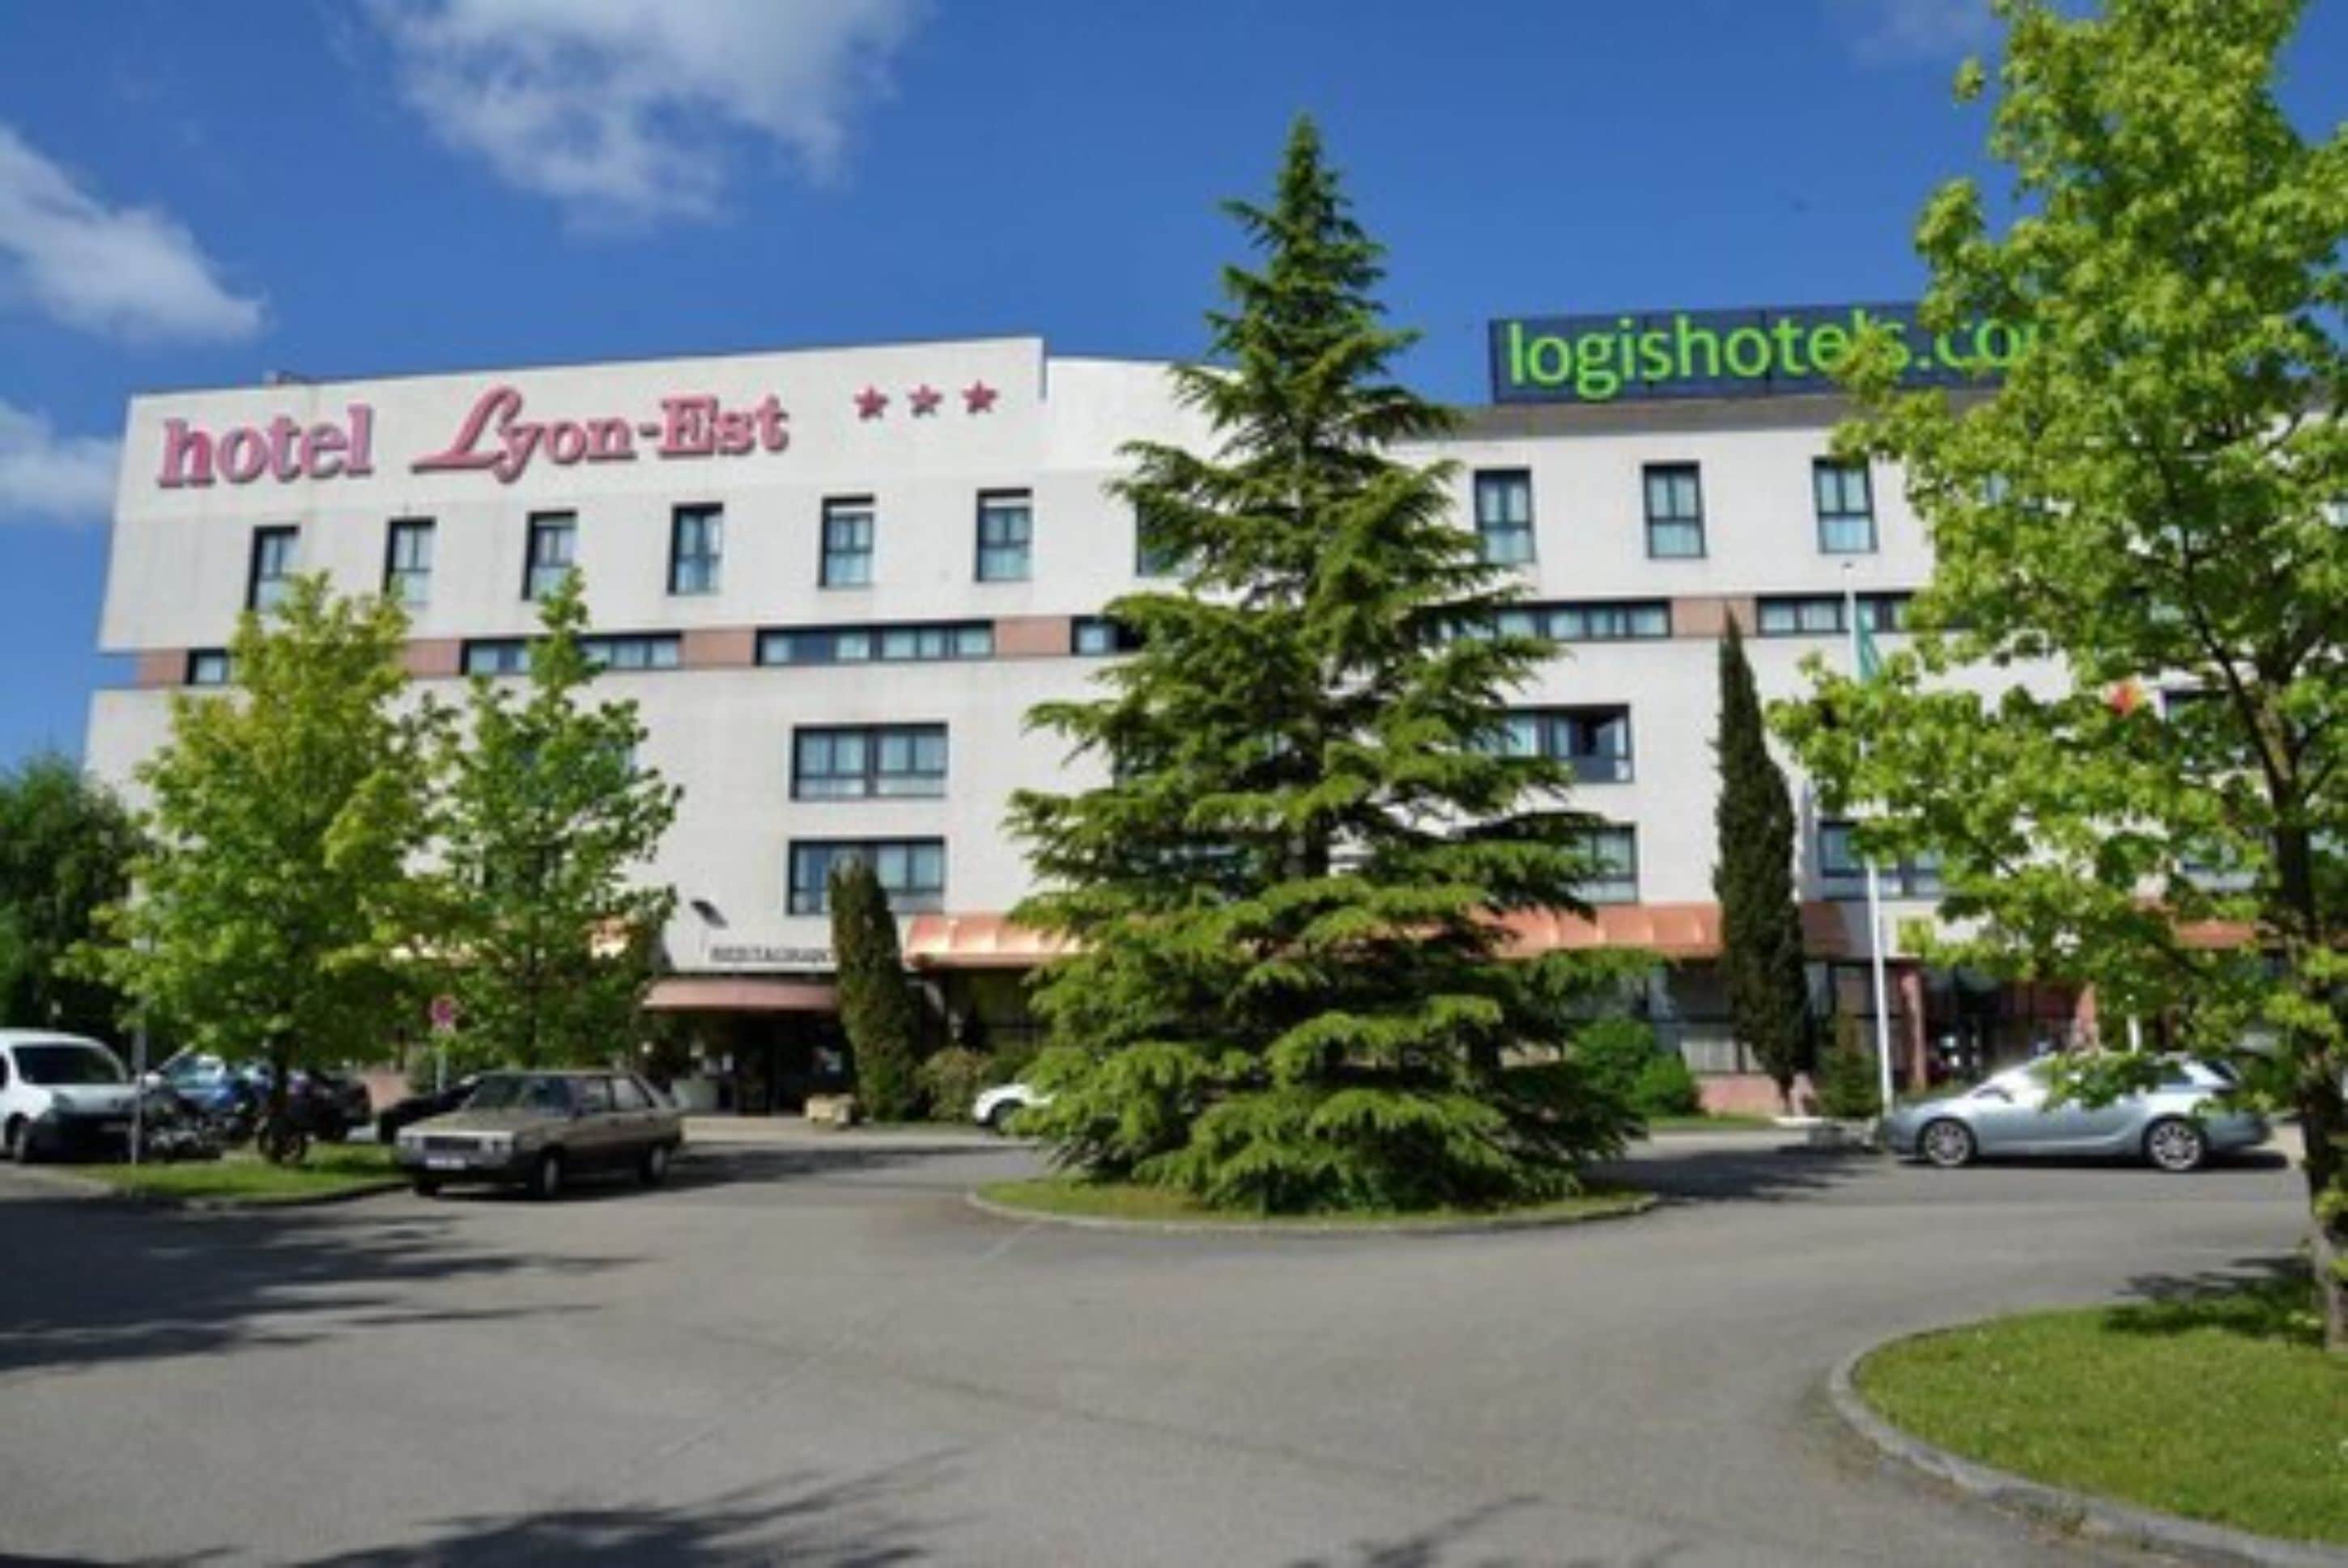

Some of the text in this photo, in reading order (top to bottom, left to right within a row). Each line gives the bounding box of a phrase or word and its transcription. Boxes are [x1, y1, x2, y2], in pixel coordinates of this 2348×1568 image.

[1509, 308, 2042, 401] logishotes.co
[157, 386, 790, 488] hotel Lyon-Est
[710, 945, 832, 963] RESTAURAN
